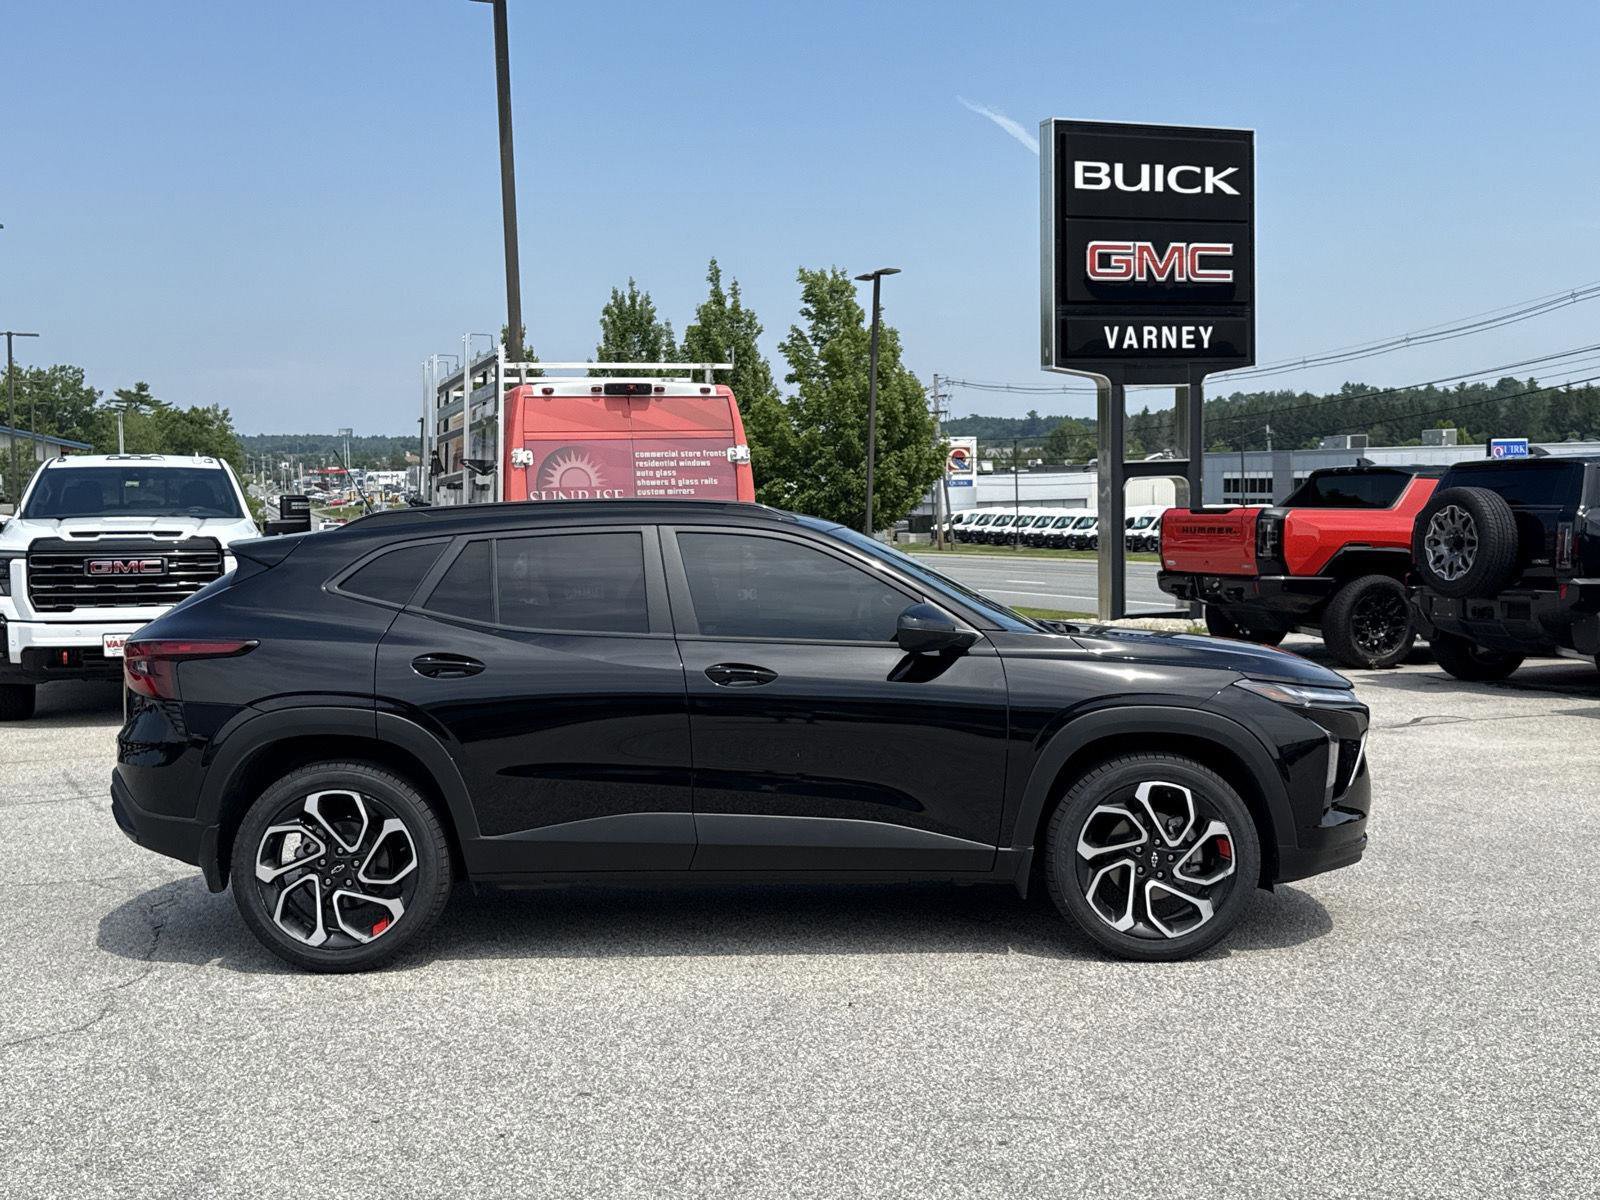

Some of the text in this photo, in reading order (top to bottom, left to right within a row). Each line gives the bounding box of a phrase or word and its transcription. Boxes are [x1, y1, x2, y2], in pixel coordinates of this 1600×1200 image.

[1074, 160, 1241, 195] BUICK
[1086, 240, 1234, 283] GMC
[1104, 325, 1213, 349] VARNEY
[635, 450, 679, 458] commercial
[655, 469, 677, 478] glass
[671, 478, 676, 486] &
[678, 478, 699, 486] glass
[701, 477, 718, 485] rails
[1182, 526, 1233, 534] HUMMER
[90, 560, 162, 574] GMC
